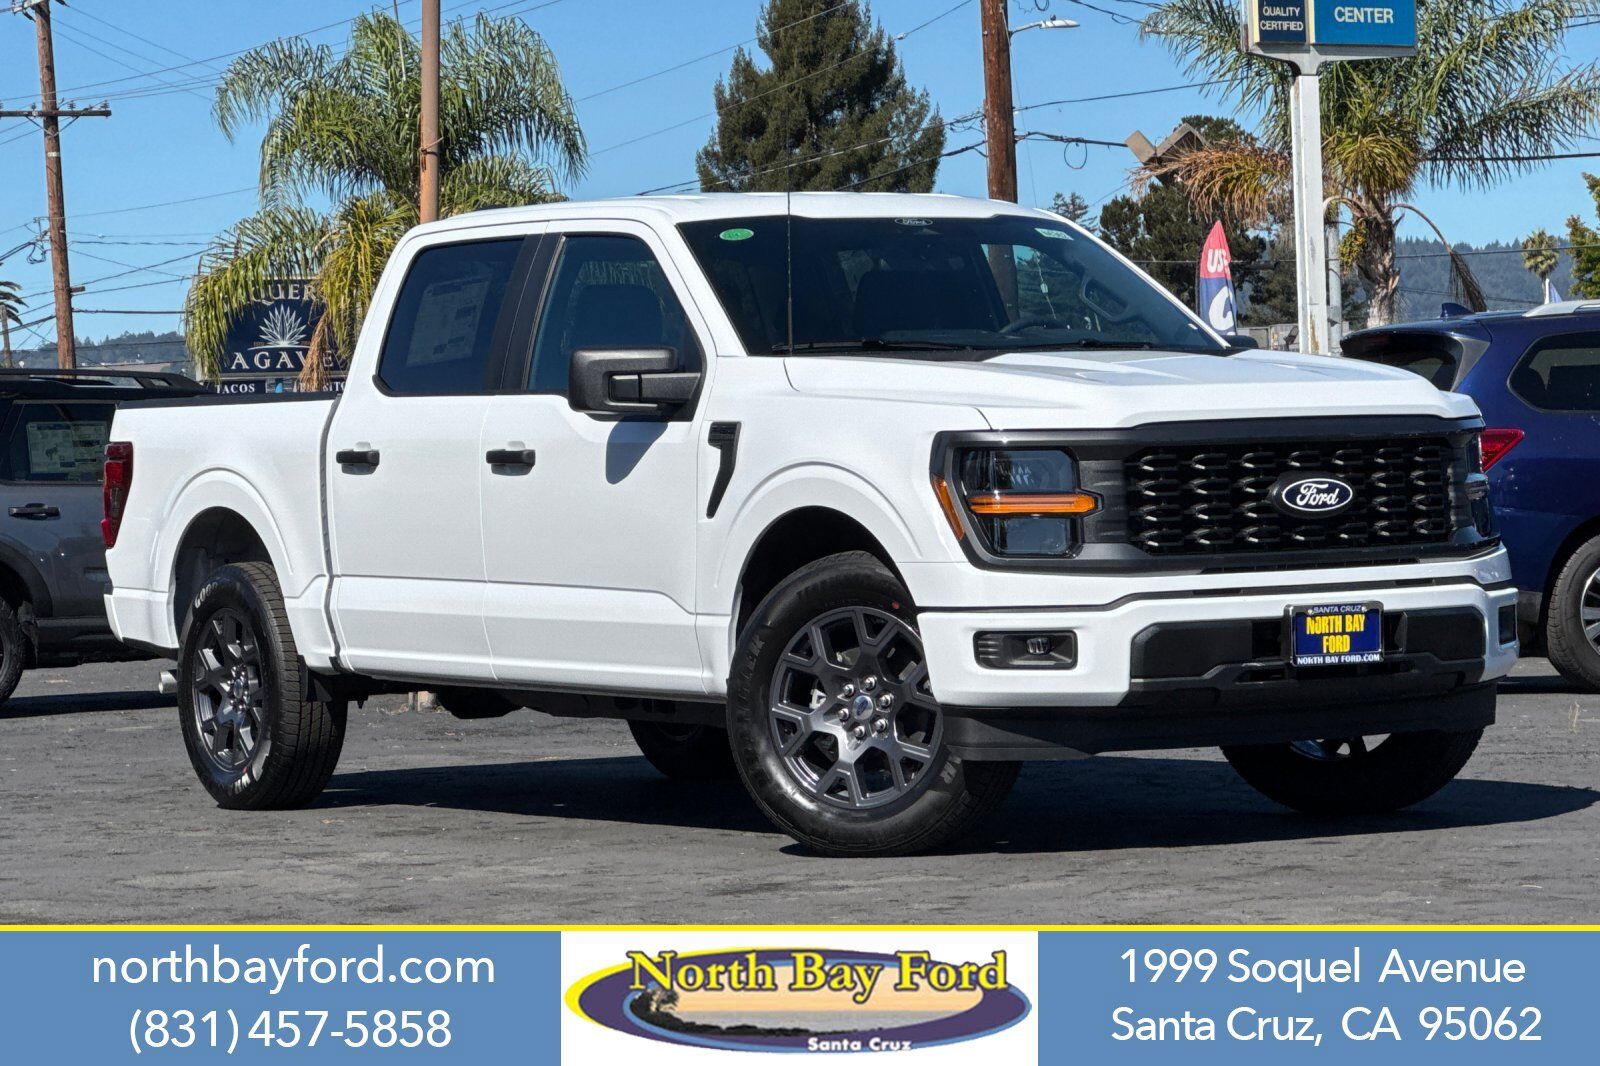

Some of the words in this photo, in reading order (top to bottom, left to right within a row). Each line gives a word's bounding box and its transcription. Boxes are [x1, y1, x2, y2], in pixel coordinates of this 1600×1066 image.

[1262, 7, 1300, 17] QUALITY
[1334, 7, 1394, 24] CENTER
[1260, 20, 1304, 31] CERTIFIED
[215, 383, 255, 394] TACOS
[1296, 482, 1340, 506] Ford
[1312, 606, 1339, 614] SANTA
[1340, 605, 1361, 613] CRUZ
[1306, 615, 1343, 635] NORTH
[1345, 614, 1365, 632] BAY
[1322, 634, 1350, 653] FORD
[1297, 656, 1324, 665] NORTH
[1325, 655, 1340, 664] BAY
[1341, 653, 1380, 663] FORD.COM
